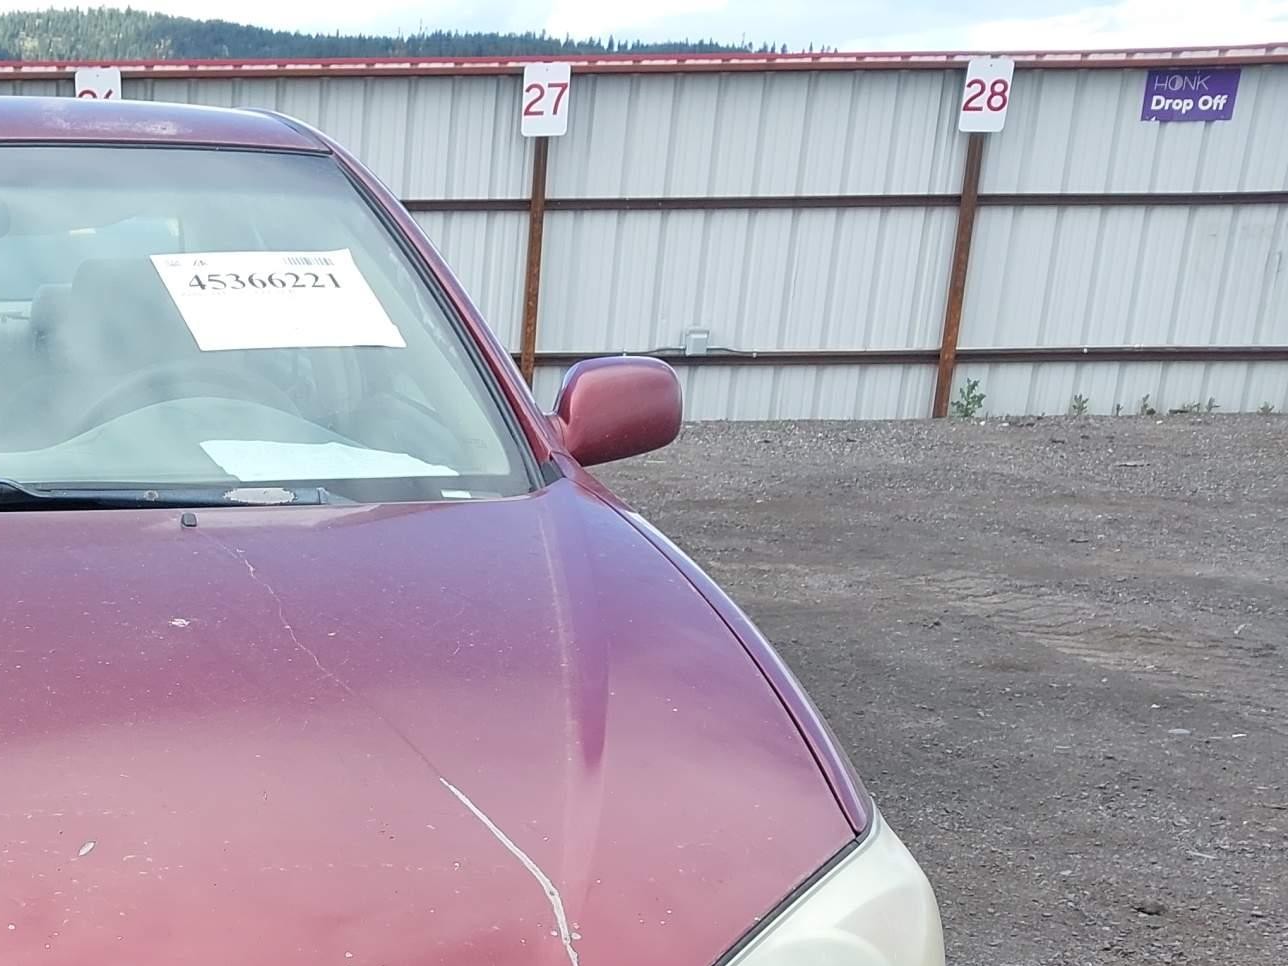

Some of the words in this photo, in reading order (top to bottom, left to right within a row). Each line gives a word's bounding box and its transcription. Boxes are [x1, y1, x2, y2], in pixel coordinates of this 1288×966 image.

[1154, 74, 1211, 91] HONK
[523, 82, 570, 117] 27
[962, 78, 1009, 113] 28
[1150, 95, 1194, 114] Drop
[1198, 94, 1229, 111] Off
[189, 272, 342, 290] 45366221
